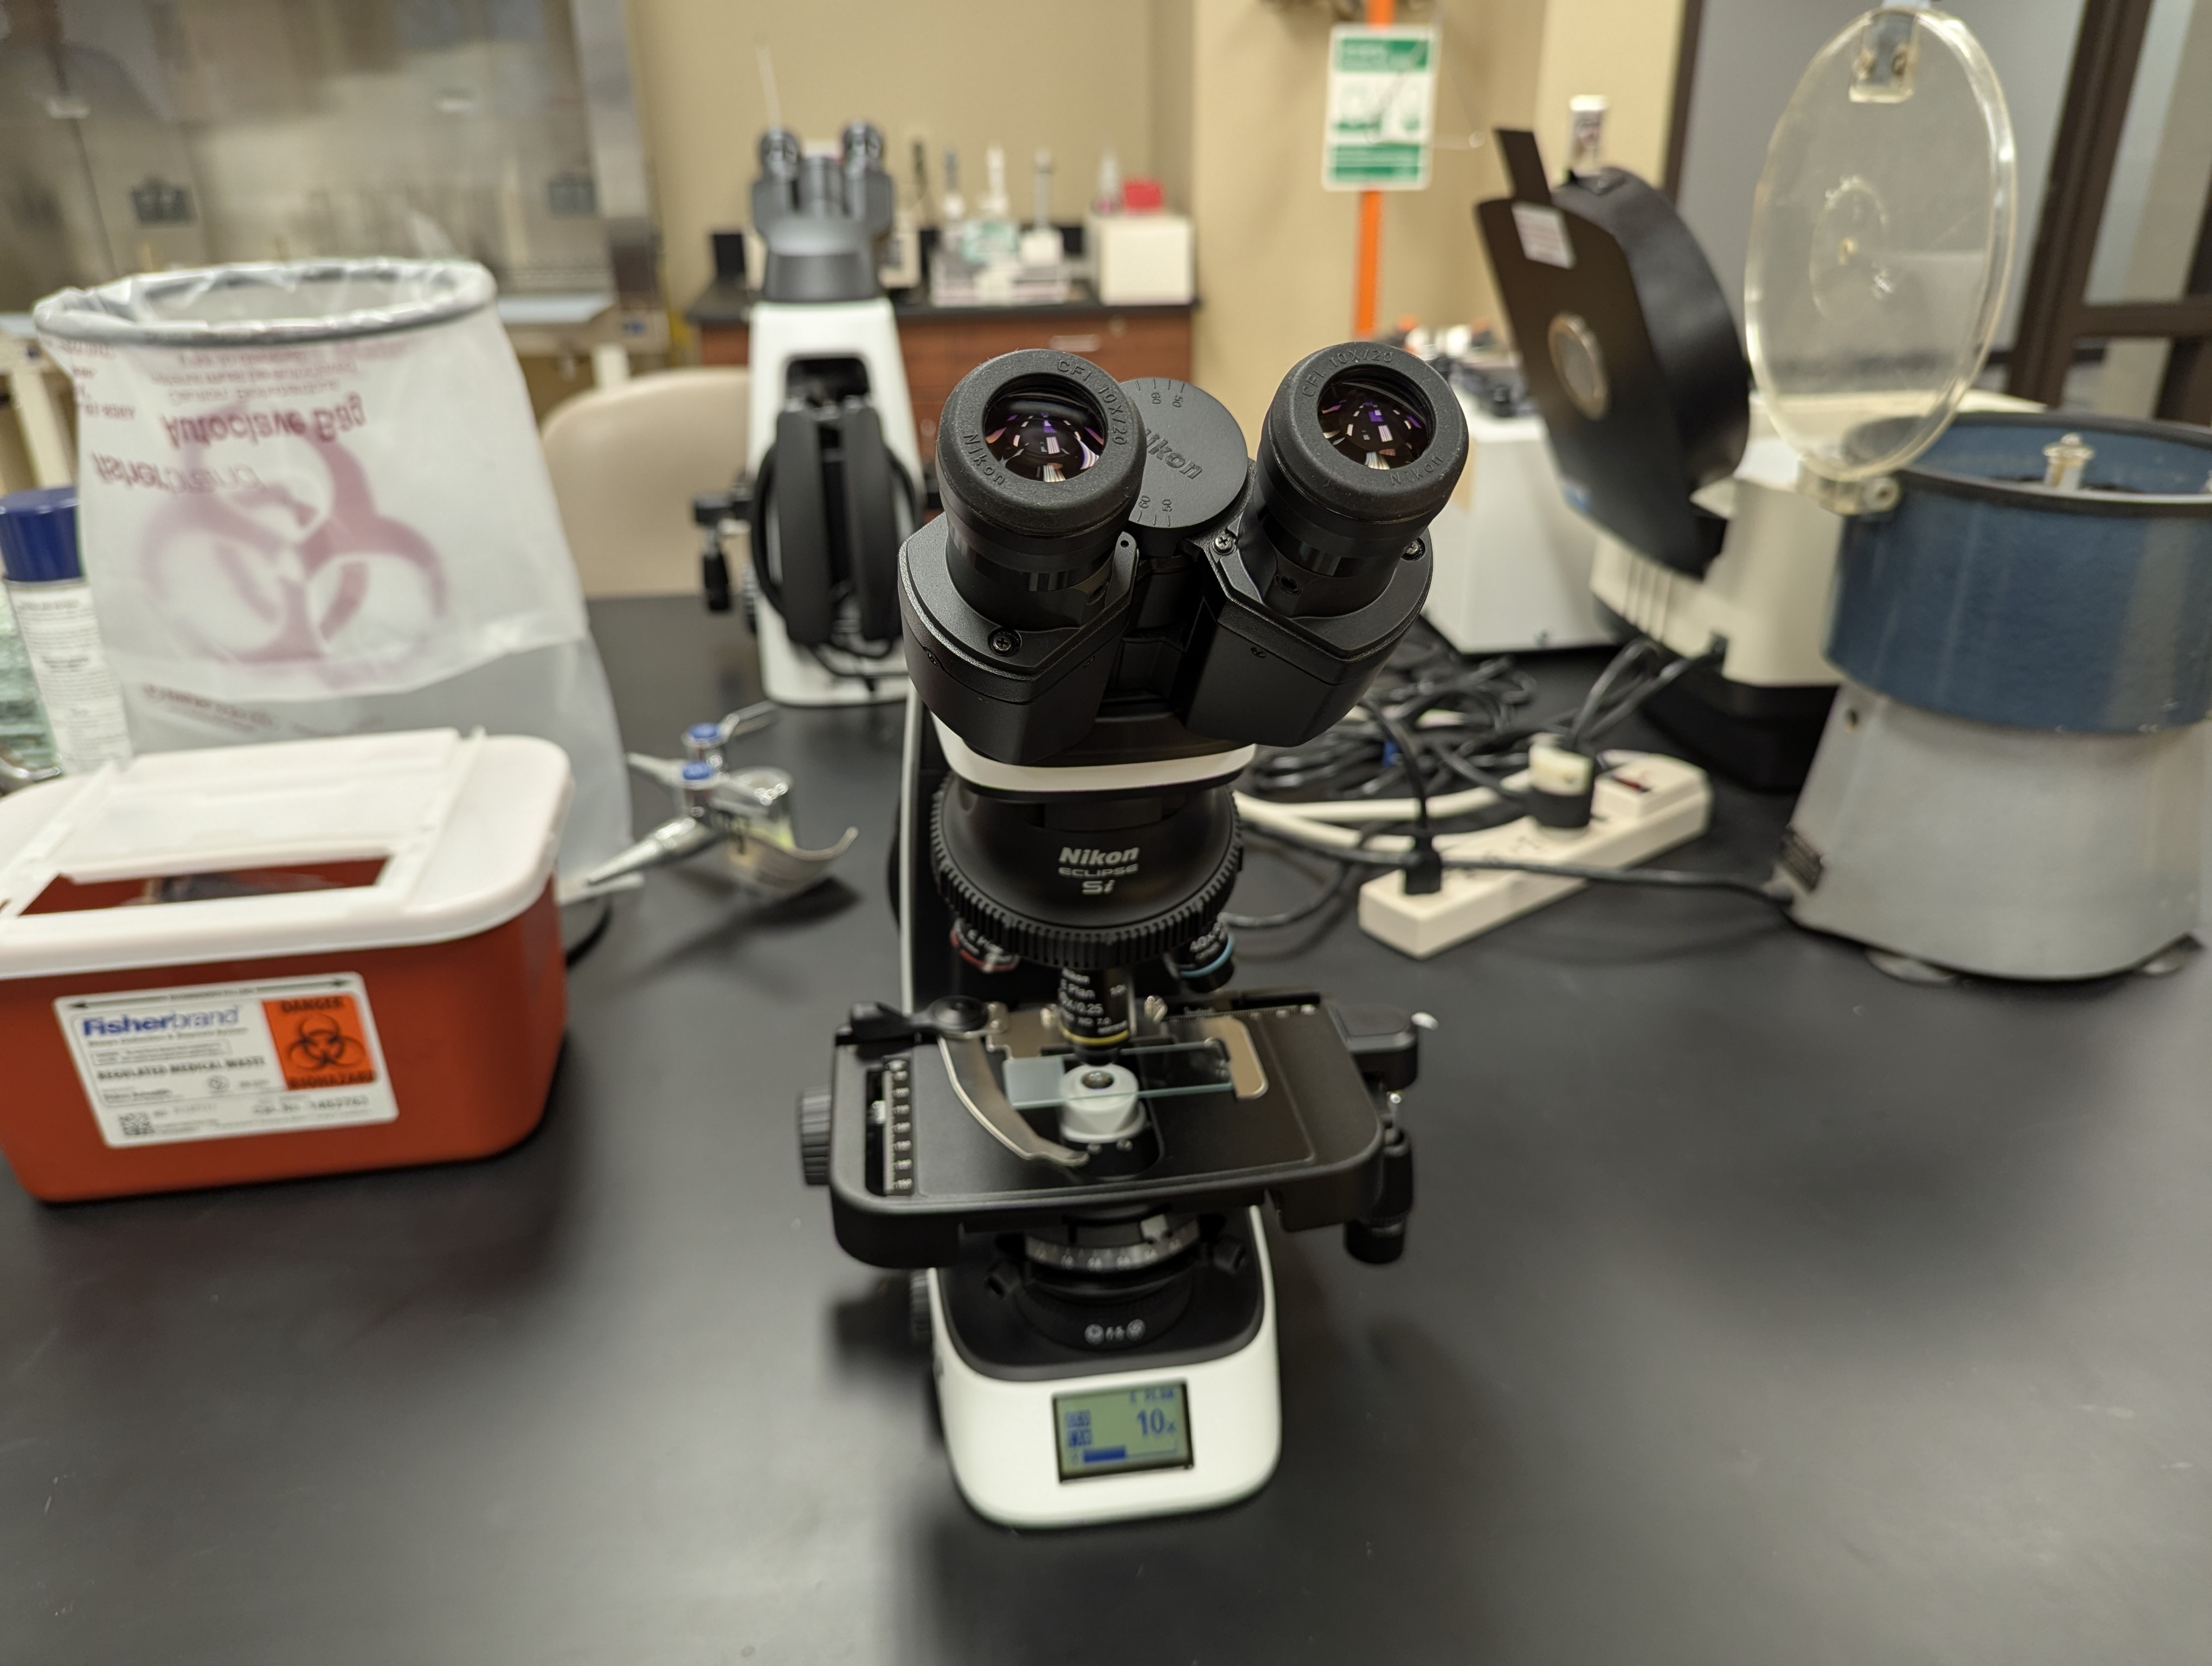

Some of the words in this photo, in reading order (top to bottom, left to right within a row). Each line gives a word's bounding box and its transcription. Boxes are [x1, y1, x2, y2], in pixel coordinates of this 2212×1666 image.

[1329, 349, 1393, 367] 10X/20
[1057, 360, 1092, 381] CFI
[1098, 387, 1128, 446] 10X/20
[1150, 392, 1161, 405] 60
[1172, 395, 1183, 408] 50
[962, 433, 1005, 486] Nikon
[1145, 428, 1203, 479] ikon
[1389, 456, 1444, 485] Nikon
[1139, 495, 1150, 509] 60
[1162, 498, 1172, 512] 50
[1058, 846, 1140, 866] Nikon
[1058, 863, 1139, 879] ECLIPSE
[1082, 879, 1115, 895] Si
[83, 1005, 239, 1036] Fisherbrand
